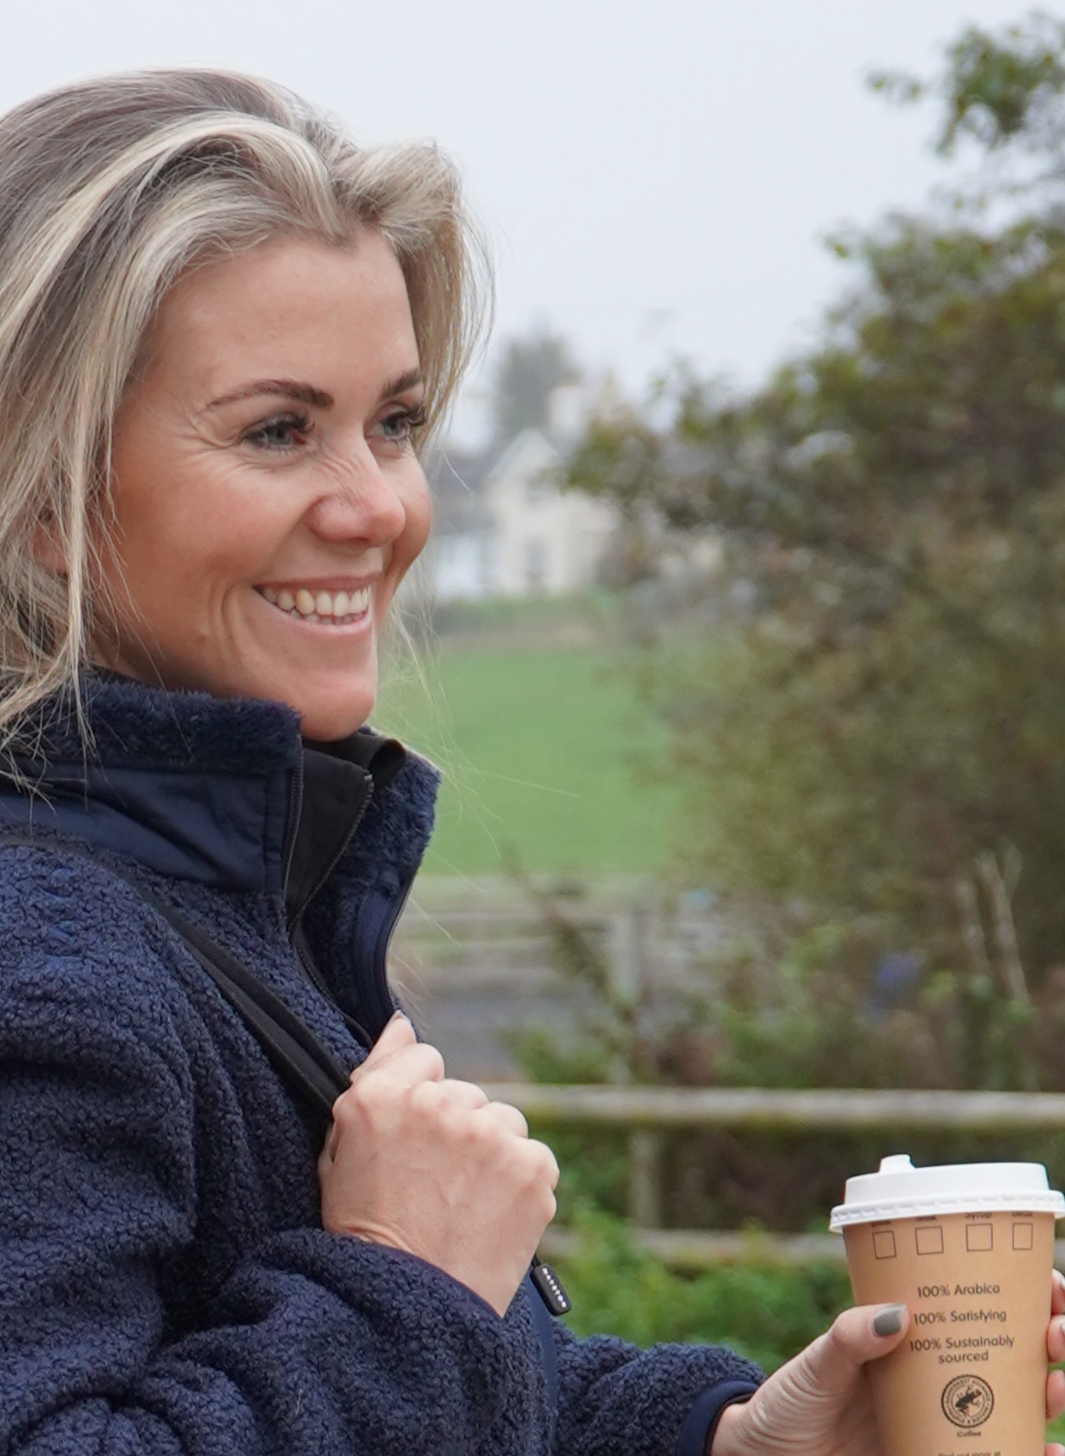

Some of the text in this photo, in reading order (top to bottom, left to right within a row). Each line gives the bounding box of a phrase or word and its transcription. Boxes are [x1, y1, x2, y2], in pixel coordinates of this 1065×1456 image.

[917, 1283, 1000, 1298] 100% Arabica
[914, 1309, 1007, 1325] 100% Satisfying
[910, 1334, 1015, 1351] 100% Sustainably
[939, 1349, 989, 1364] sourced
